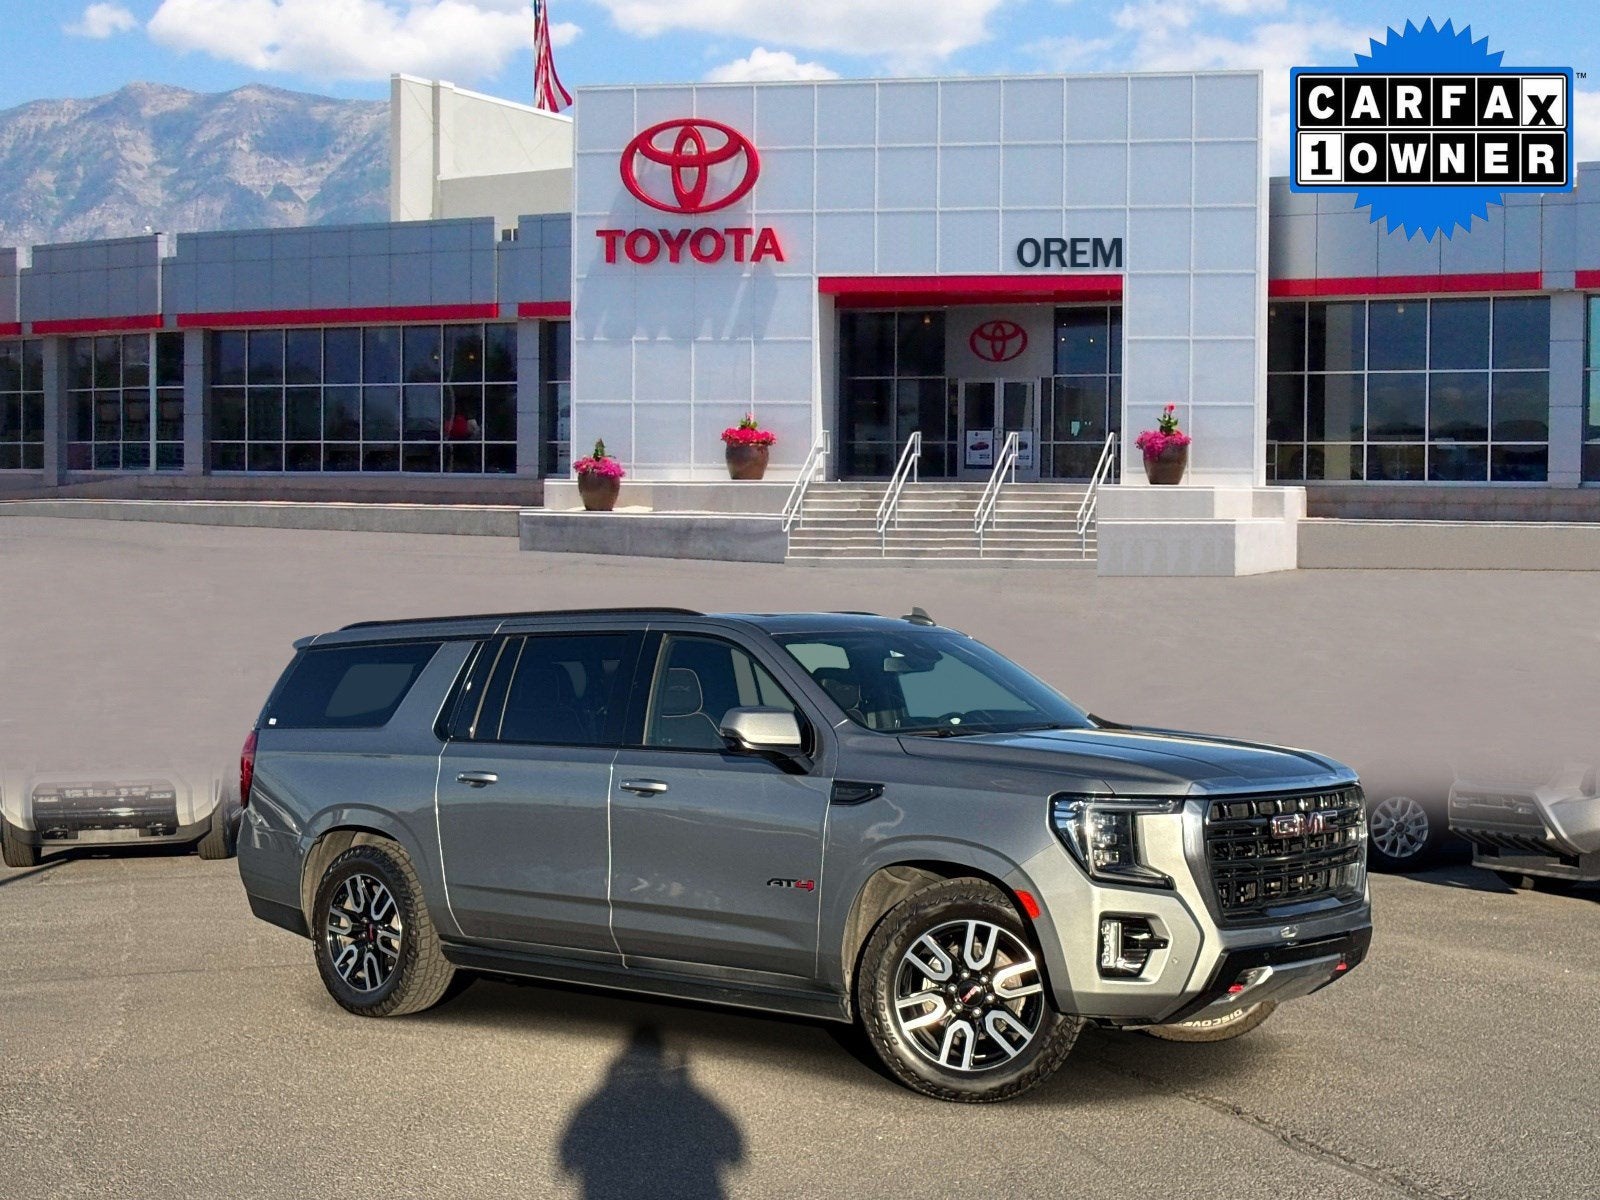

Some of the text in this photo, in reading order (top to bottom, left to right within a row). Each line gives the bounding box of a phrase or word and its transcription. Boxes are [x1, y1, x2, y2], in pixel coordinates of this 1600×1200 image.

[596, 227, 784, 264] TOYOTA
[1017, 237, 1123, 268] OREM
[1271, 810, 1339, 840] GMC
[766, 878, 815, 892] AT4
[1180, 1008, 1244, 1028] DISCOVE
